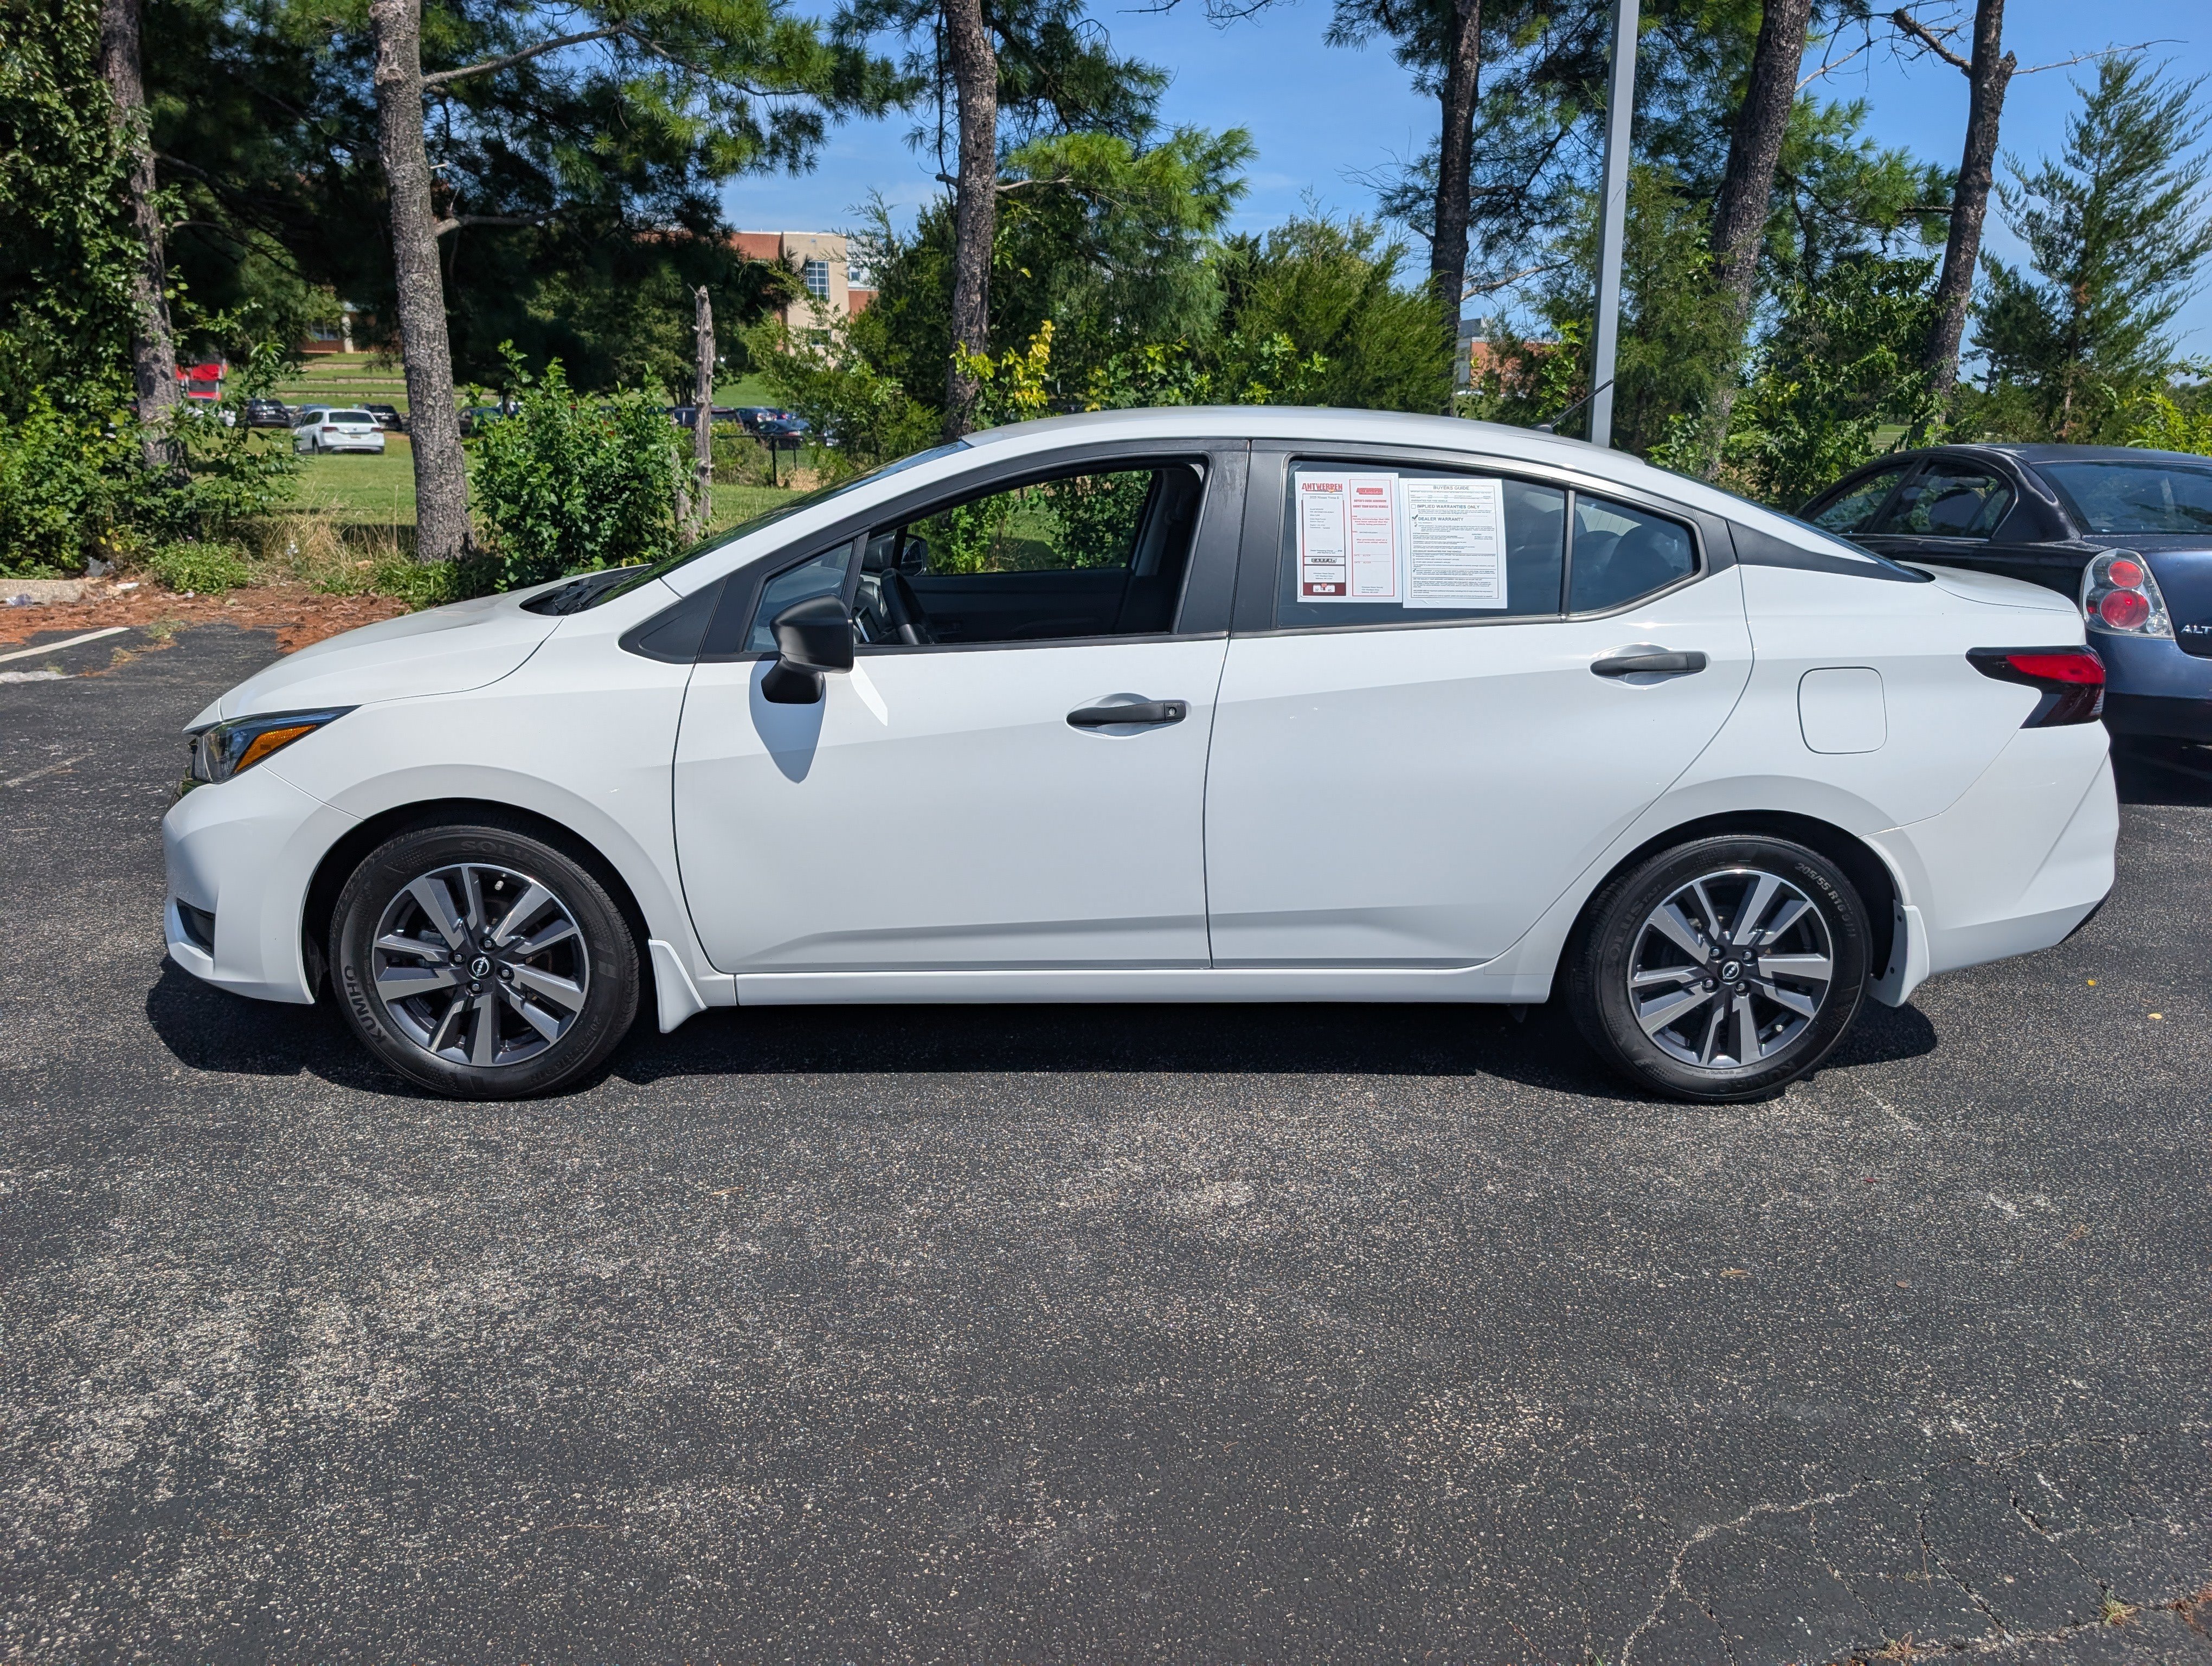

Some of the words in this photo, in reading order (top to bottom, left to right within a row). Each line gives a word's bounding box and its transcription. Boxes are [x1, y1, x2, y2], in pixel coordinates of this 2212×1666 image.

[1795, 862, 1831, 890] 205/55
[1828, 890, 1846, 912] R16
[344, 965, 387, 1042] KUMHO
